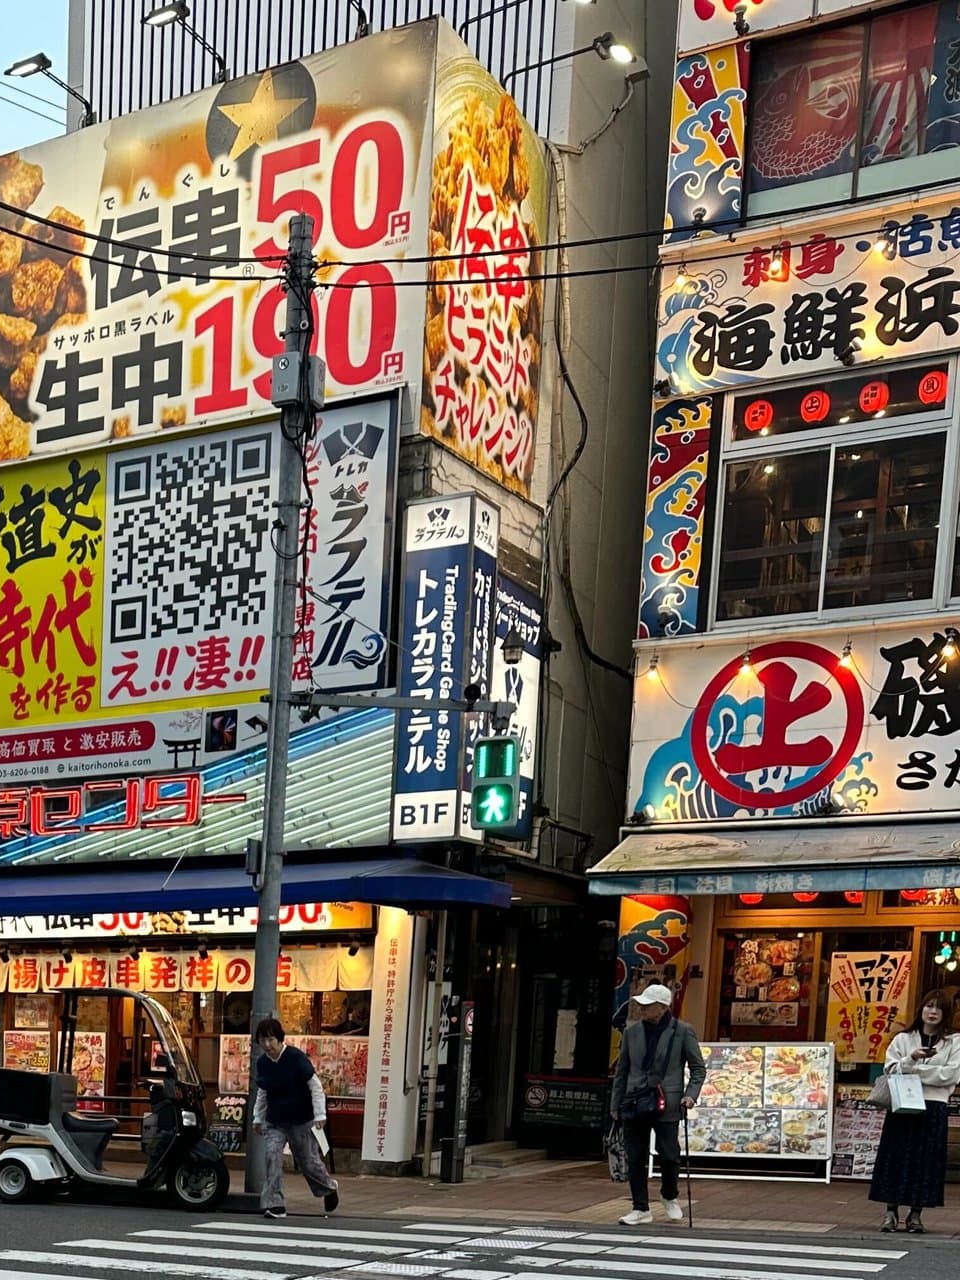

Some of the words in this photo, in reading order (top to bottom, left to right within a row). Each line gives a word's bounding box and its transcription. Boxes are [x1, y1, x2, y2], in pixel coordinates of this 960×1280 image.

[103, 162, 231, 211] でんぐし
[89, 187, 239, 311] 伝串
[53, 310, 175, 349] サッポロ黒ラベル
[447, 283, 529, 397] ピラミッド
[36, 333, 183, 444] 生中
[310, 500, 369, 668] ラフテル
[440, 565, 459, 673] TradingCard
[9, 673, 97, 720] を作る
[438, 676, 453, 725] Gae
[79, 729, 143, 751] 激安販売
[434, 728, 451, 772] Shop
[67, 756, 152, 773] kaitorihonoka.com
[399, 802, 449, 826] B1F
[11, 955, 295, 989] 揚げ皮串発祥の店
[854, 959, 877, 1003] アワー
[876, 953, 898, 1002] ハッピー
[218, 1105, 243, 1121] 190
